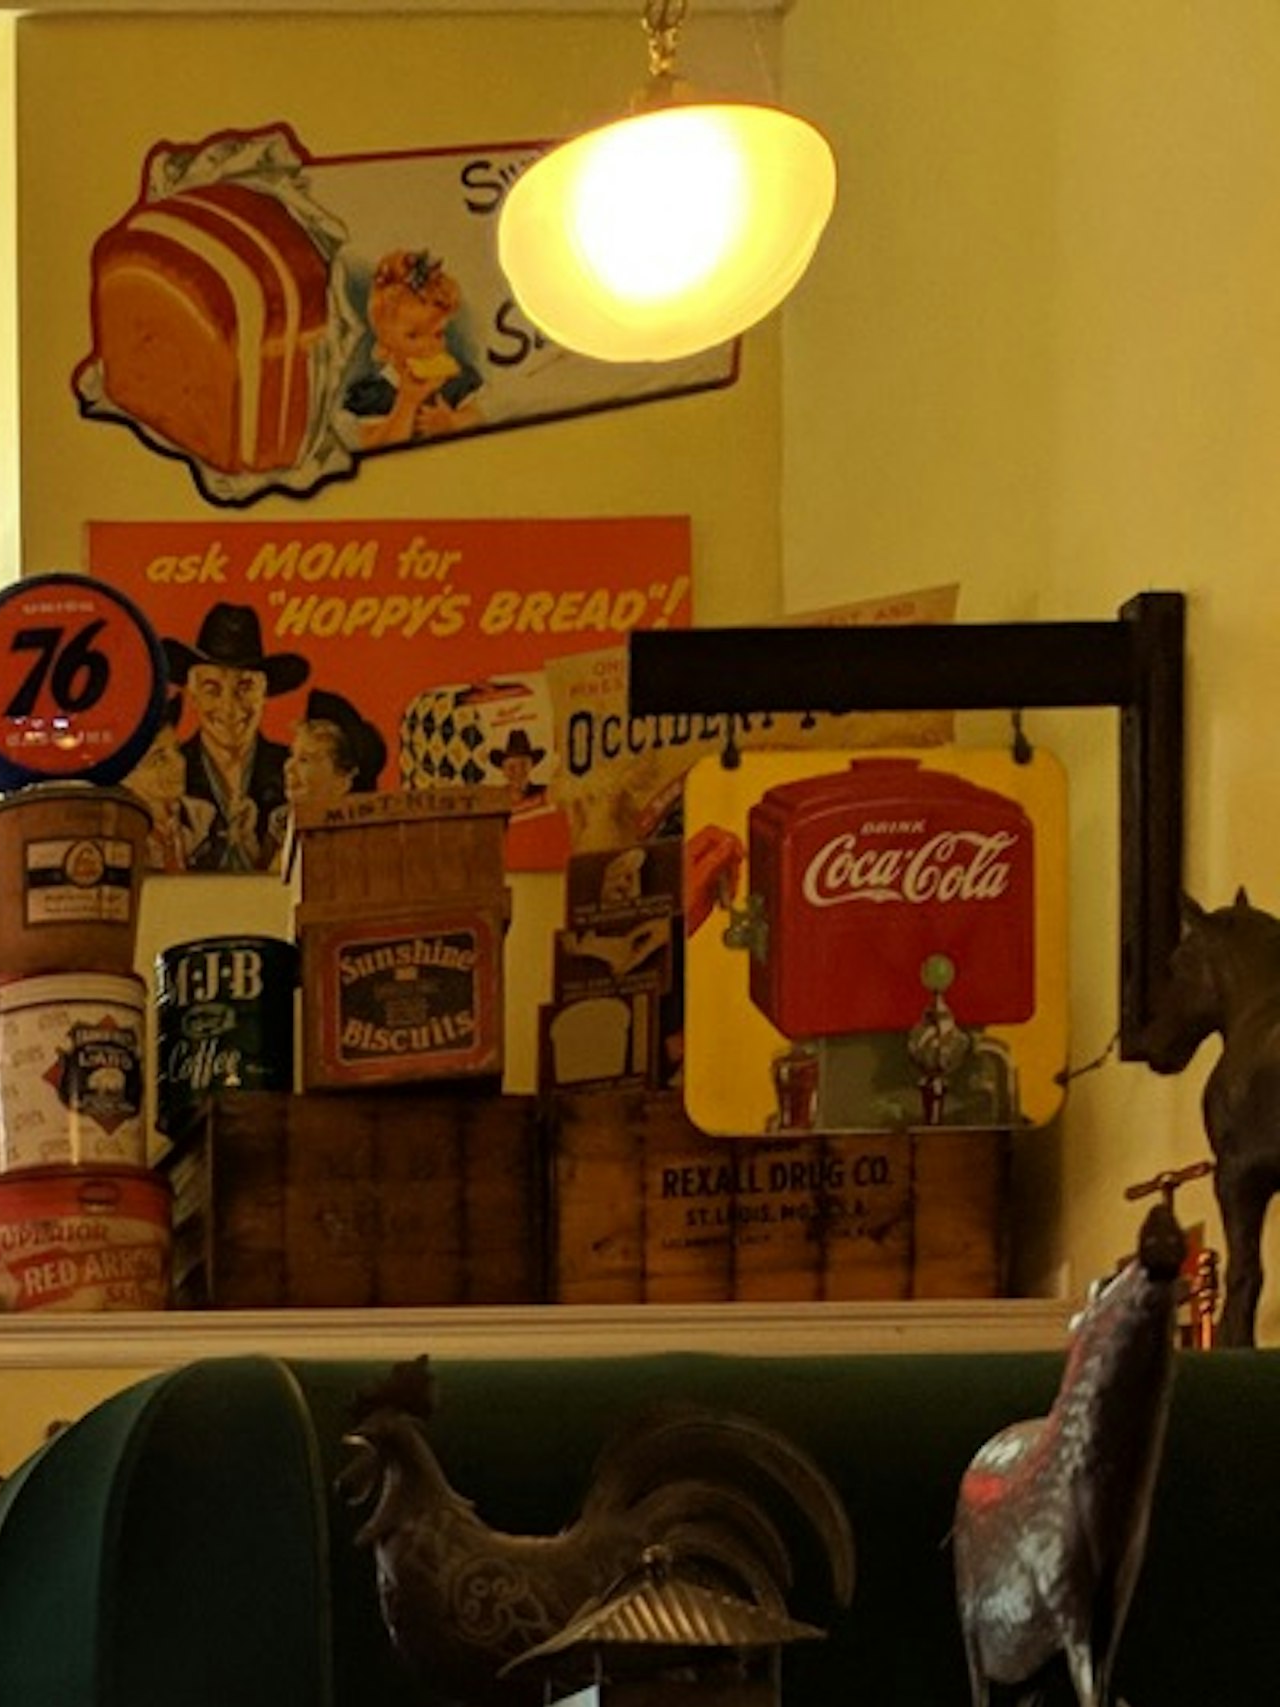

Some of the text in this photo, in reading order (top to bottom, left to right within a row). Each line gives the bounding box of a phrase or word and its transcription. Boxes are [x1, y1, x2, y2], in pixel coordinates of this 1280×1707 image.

[146, 536, 462, 583] ask MOM for
[2, 619, 111, 720] 76
[860, 819, 928, 835] DRINK
[802, 831, 1019, 907] Coca-Cola
[339, 938, 477, 985] Sunshine
[167, 1037, 242, 1089] Coffee
[662, 1164, 762, 1199] REXALL
[768, 1160, 845, 1193] DRUG
[23, 1258, 77, 1297] RED
